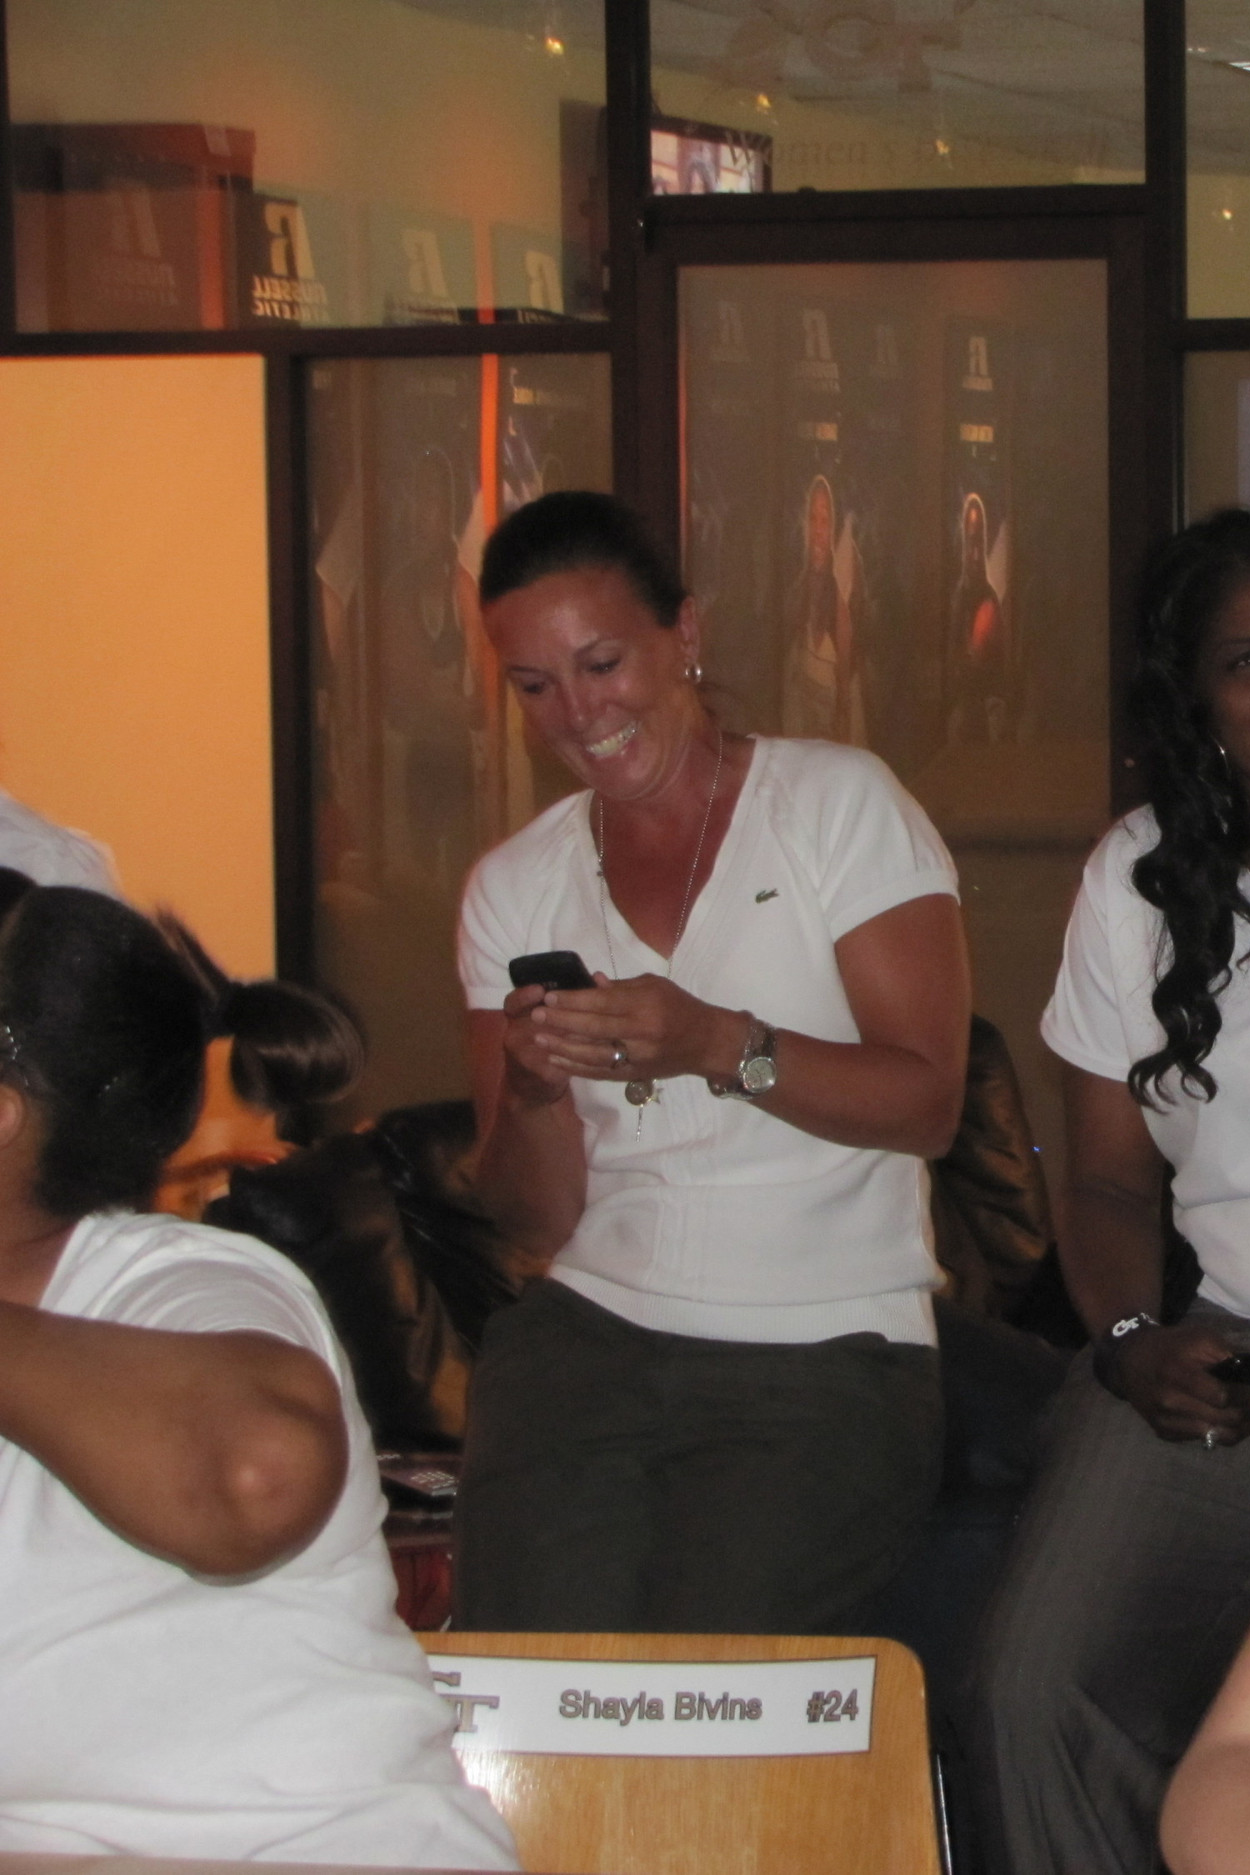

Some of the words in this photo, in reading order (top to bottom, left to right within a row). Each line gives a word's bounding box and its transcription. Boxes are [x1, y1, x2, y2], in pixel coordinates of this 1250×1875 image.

[559, 1688, 664, 1727] Shayla
[674, 1691, 763, 1721] Bivins
[806, 1688, 859, 1723] #24
